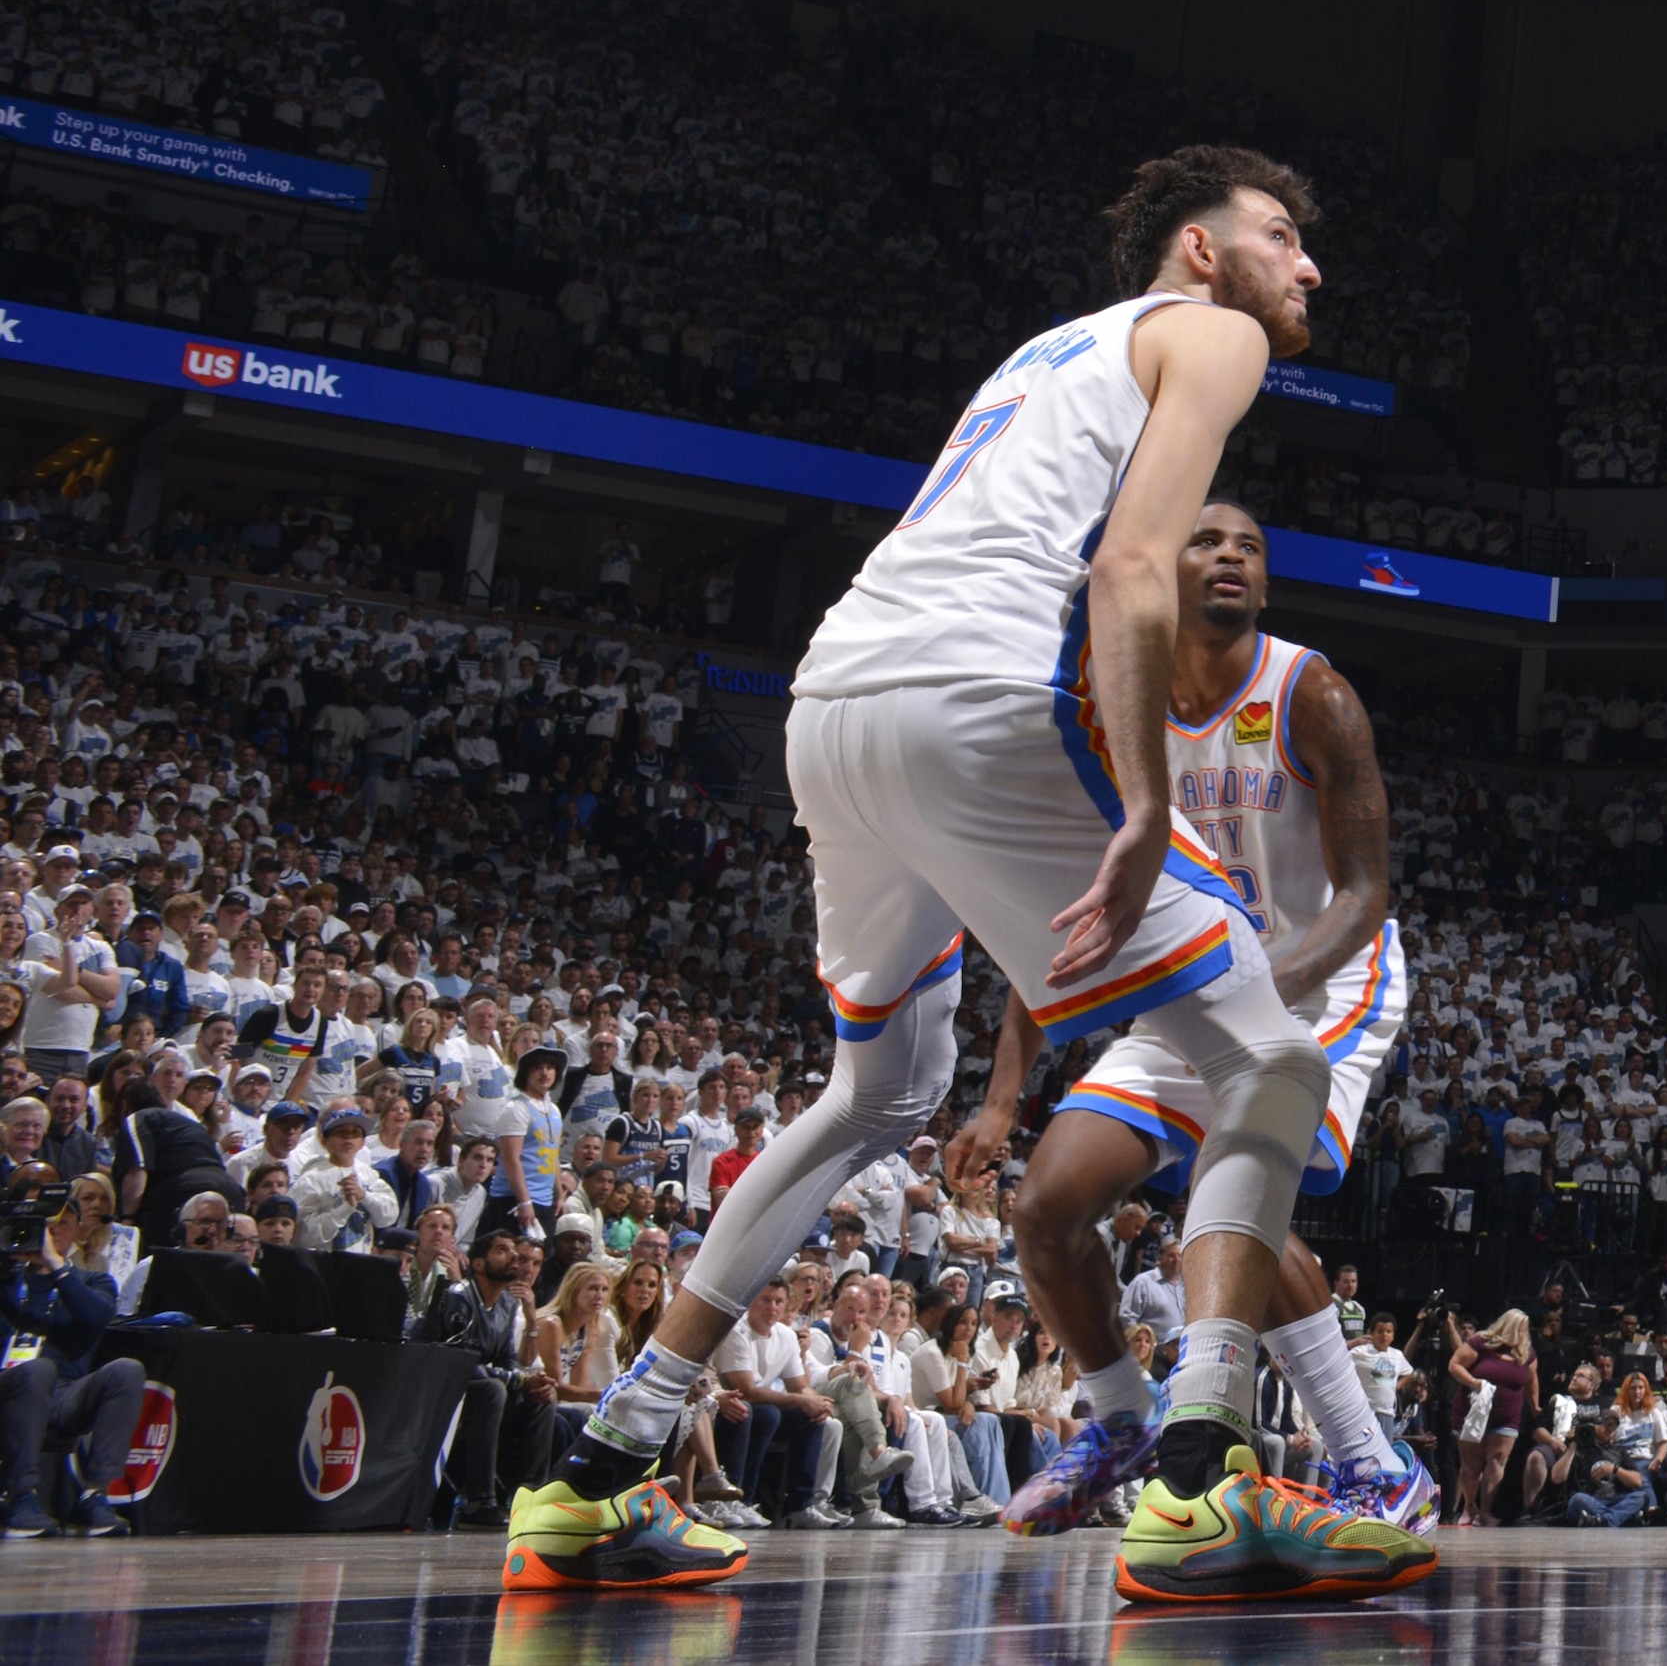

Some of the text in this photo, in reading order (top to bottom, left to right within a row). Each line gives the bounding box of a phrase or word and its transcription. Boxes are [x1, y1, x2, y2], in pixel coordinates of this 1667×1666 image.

[55, 111, 247, 163] Step up your game with
[52, 130, 295, 192] U.S. Bank Checking.
[187, 349, 236, 382] us
[1283, 381, 1341, 404] Checking.
[894, 394, 1026, 531] 7
[273, 1067, 288, 1084] 3
[412, 1087, 423, 1103] 5
[670, 1156, 681, 1171] 5
[324, 1450, 355, 1464] ESPN
